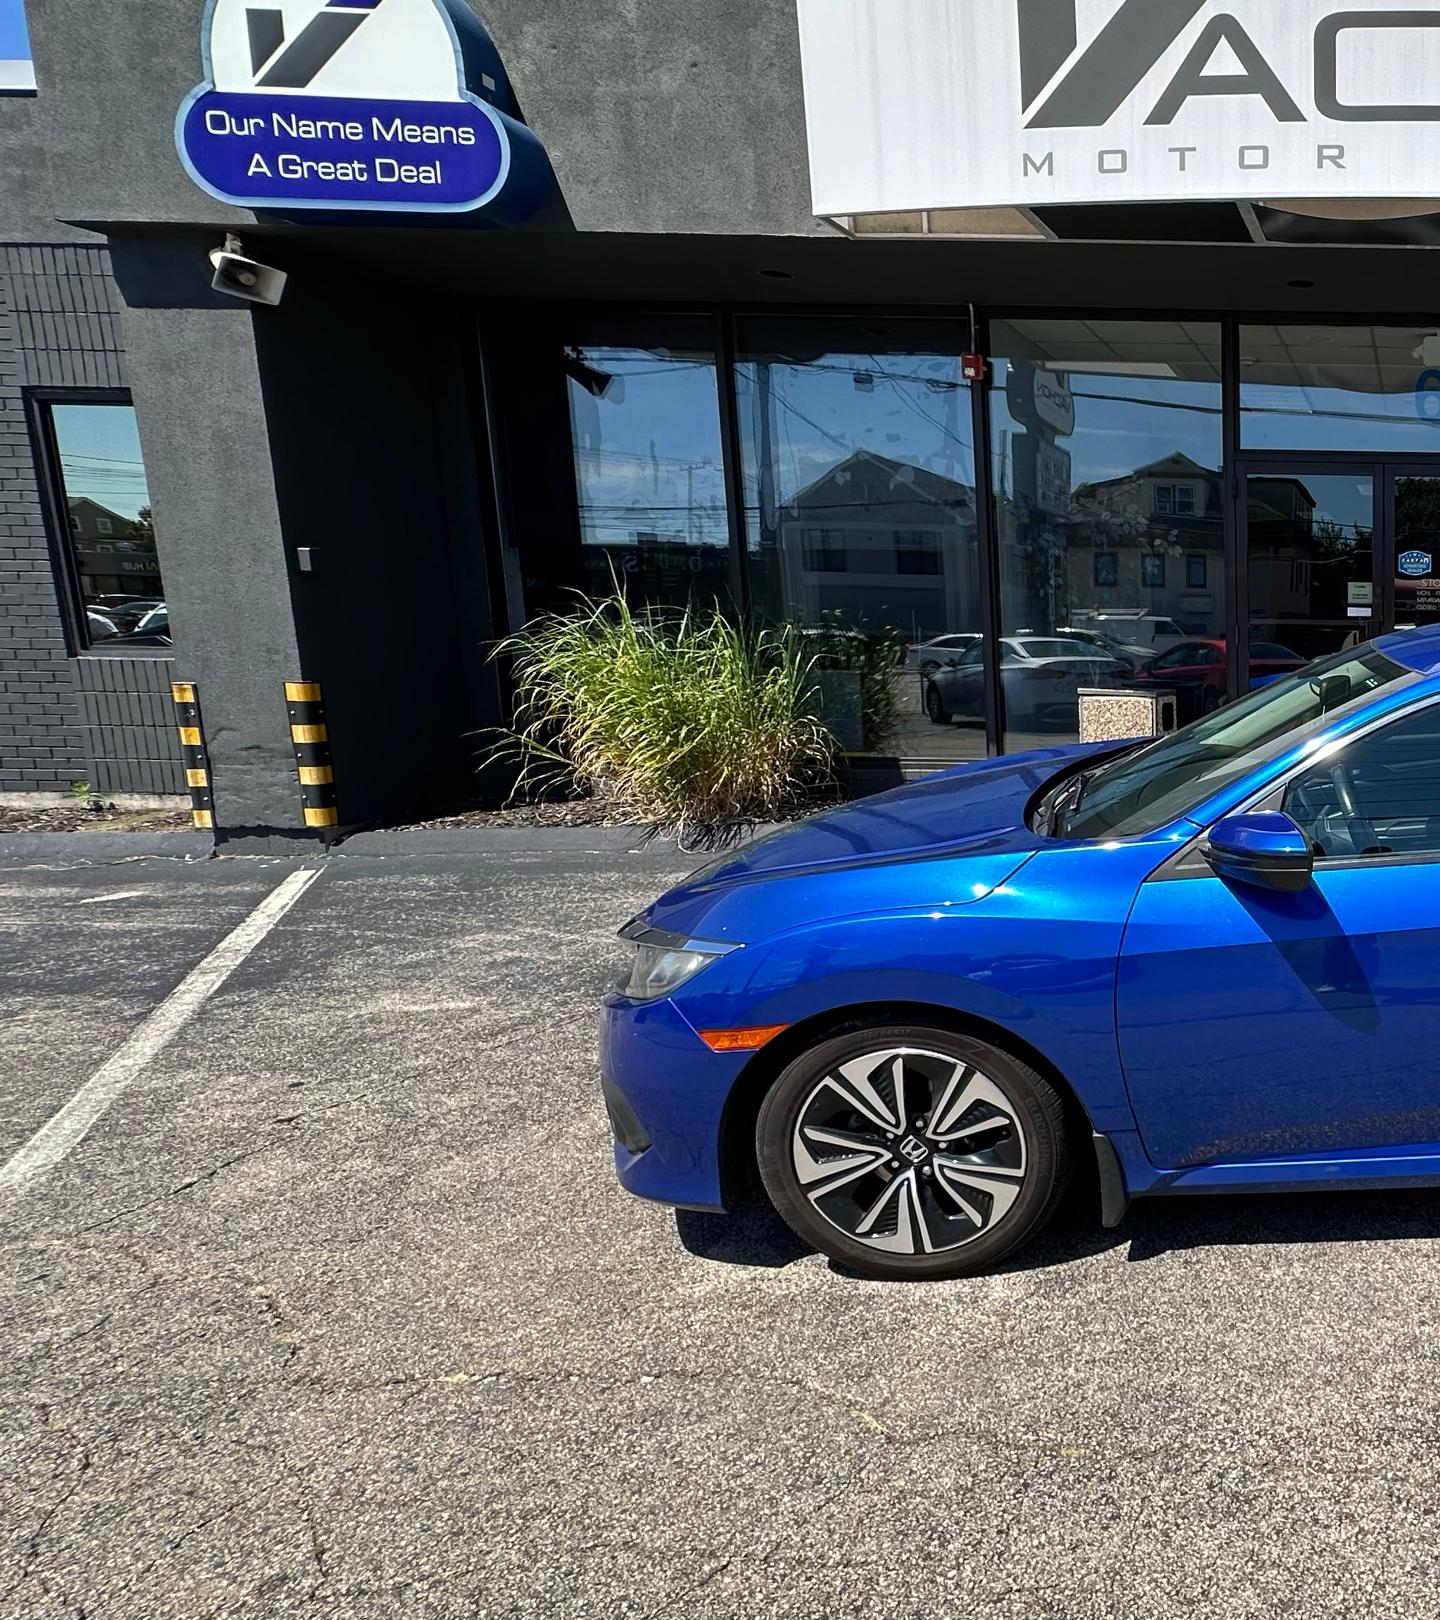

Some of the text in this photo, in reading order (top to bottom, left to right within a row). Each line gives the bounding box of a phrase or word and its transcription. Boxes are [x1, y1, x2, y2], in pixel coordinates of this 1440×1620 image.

[204, 109, 477, 146] Our Name Means
[247, 153, 442, 185] A Great Deal
[1022, 144, 1346, 177] MOTOR
